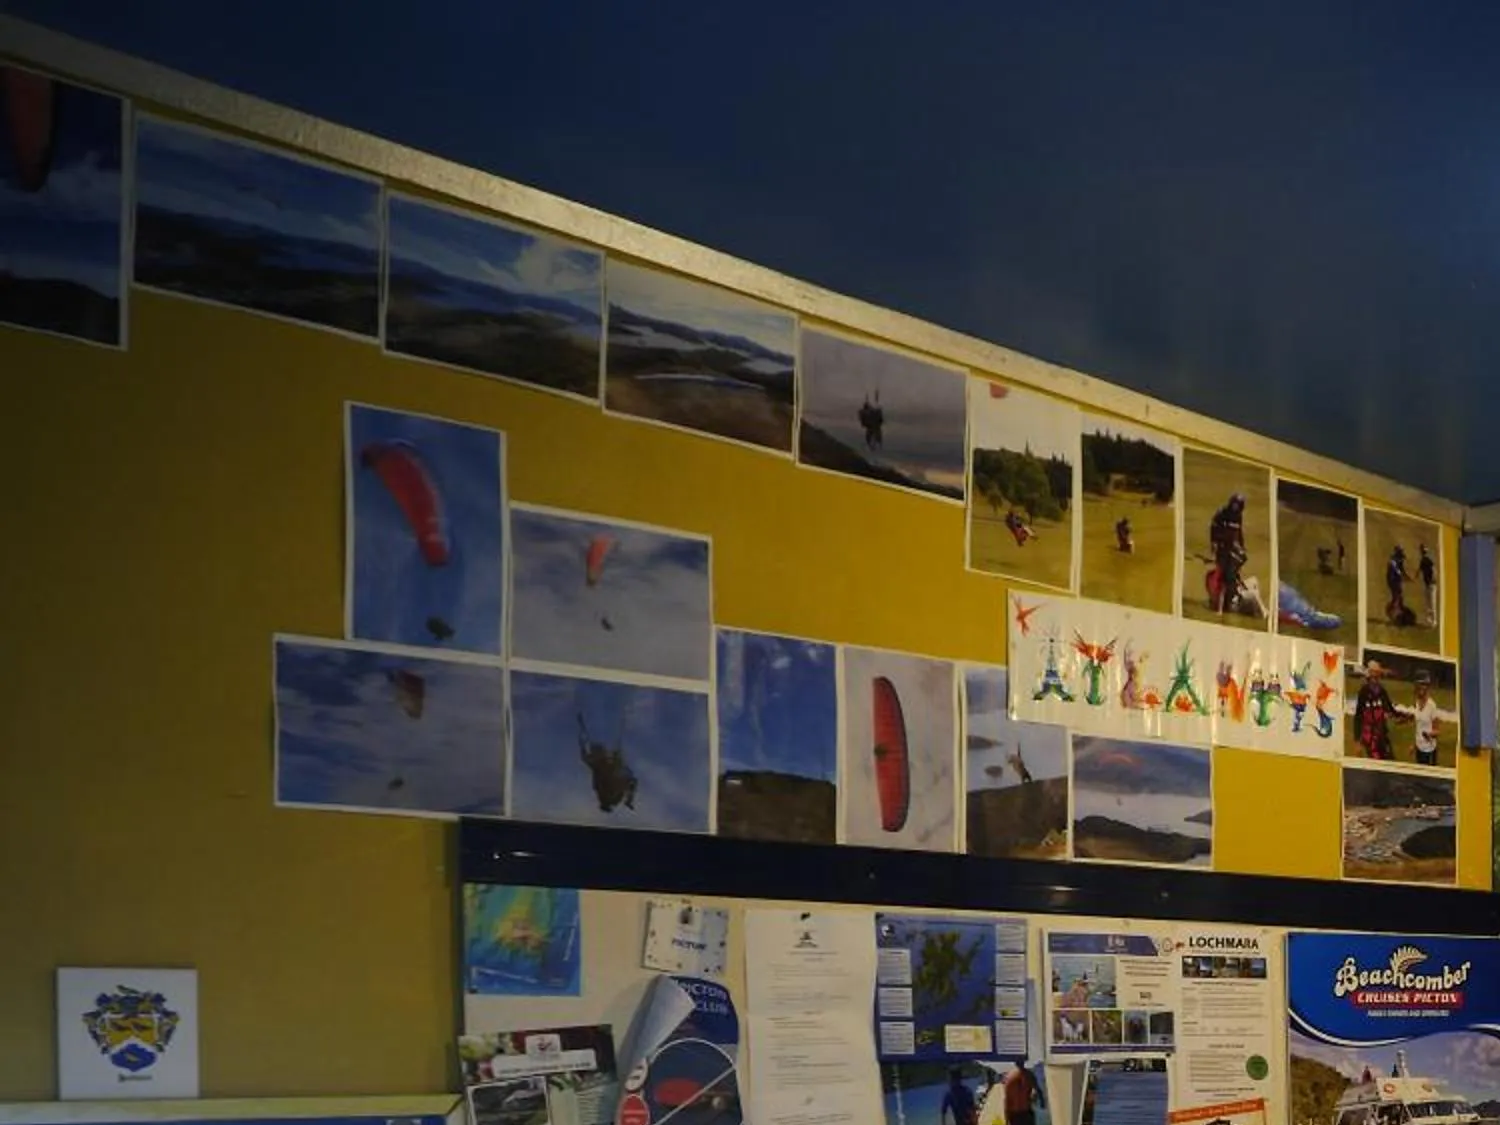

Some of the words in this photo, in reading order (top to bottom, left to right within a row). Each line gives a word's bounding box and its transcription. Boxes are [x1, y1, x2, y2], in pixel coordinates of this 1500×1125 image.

[1188, 937, 1259, 949] LOCHMARA
[1333, 953, 1471, 997] Beachcomber
[1357, 991, 1409, 1004] CRUISES
[1412, 991, 1458, 1004] PICTON
